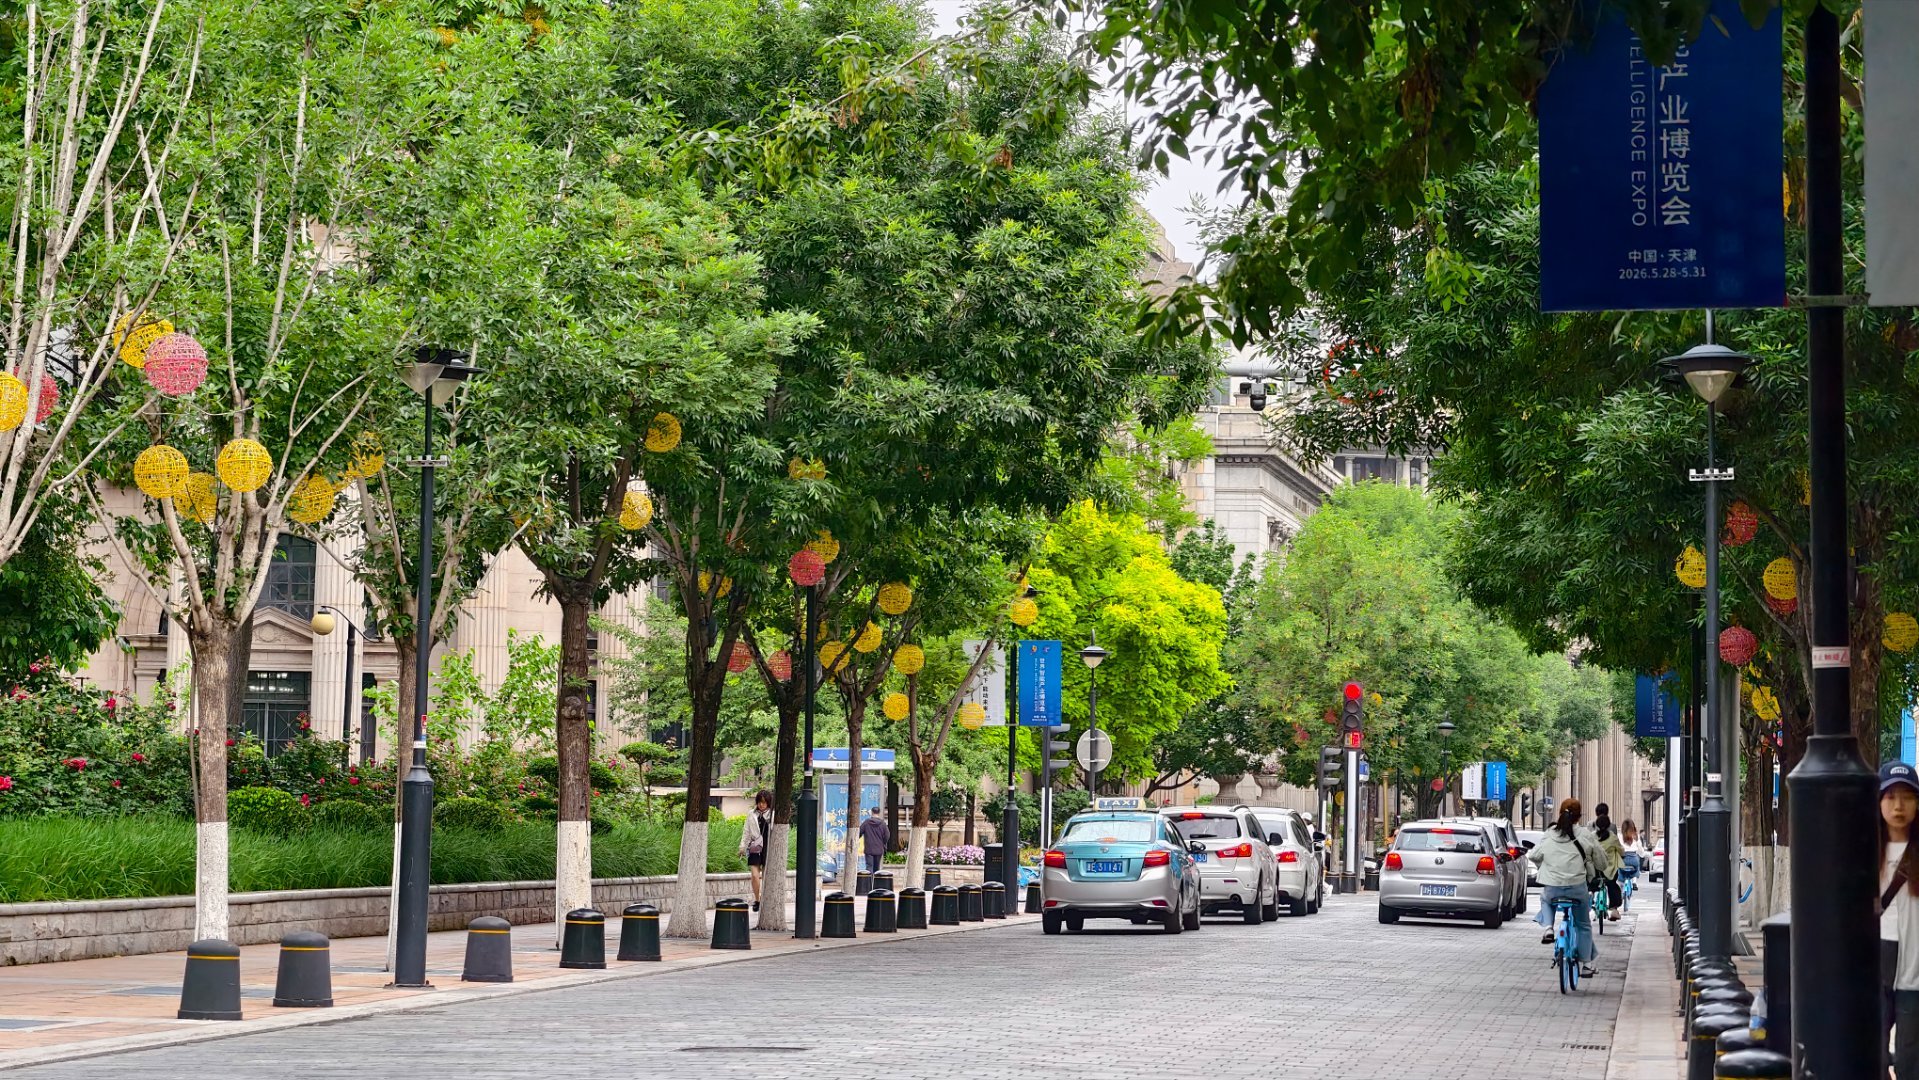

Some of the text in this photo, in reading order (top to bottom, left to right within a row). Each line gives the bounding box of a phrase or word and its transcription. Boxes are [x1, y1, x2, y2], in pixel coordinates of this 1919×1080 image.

[1659, 27, 1691, 226] 产业博览会
[1630, 170, 1648, 227] EXPO
[1617, 266, 1707, 280] 2026.5.28-5.31
[1628, 248, 1697, 264] 中国·天津
